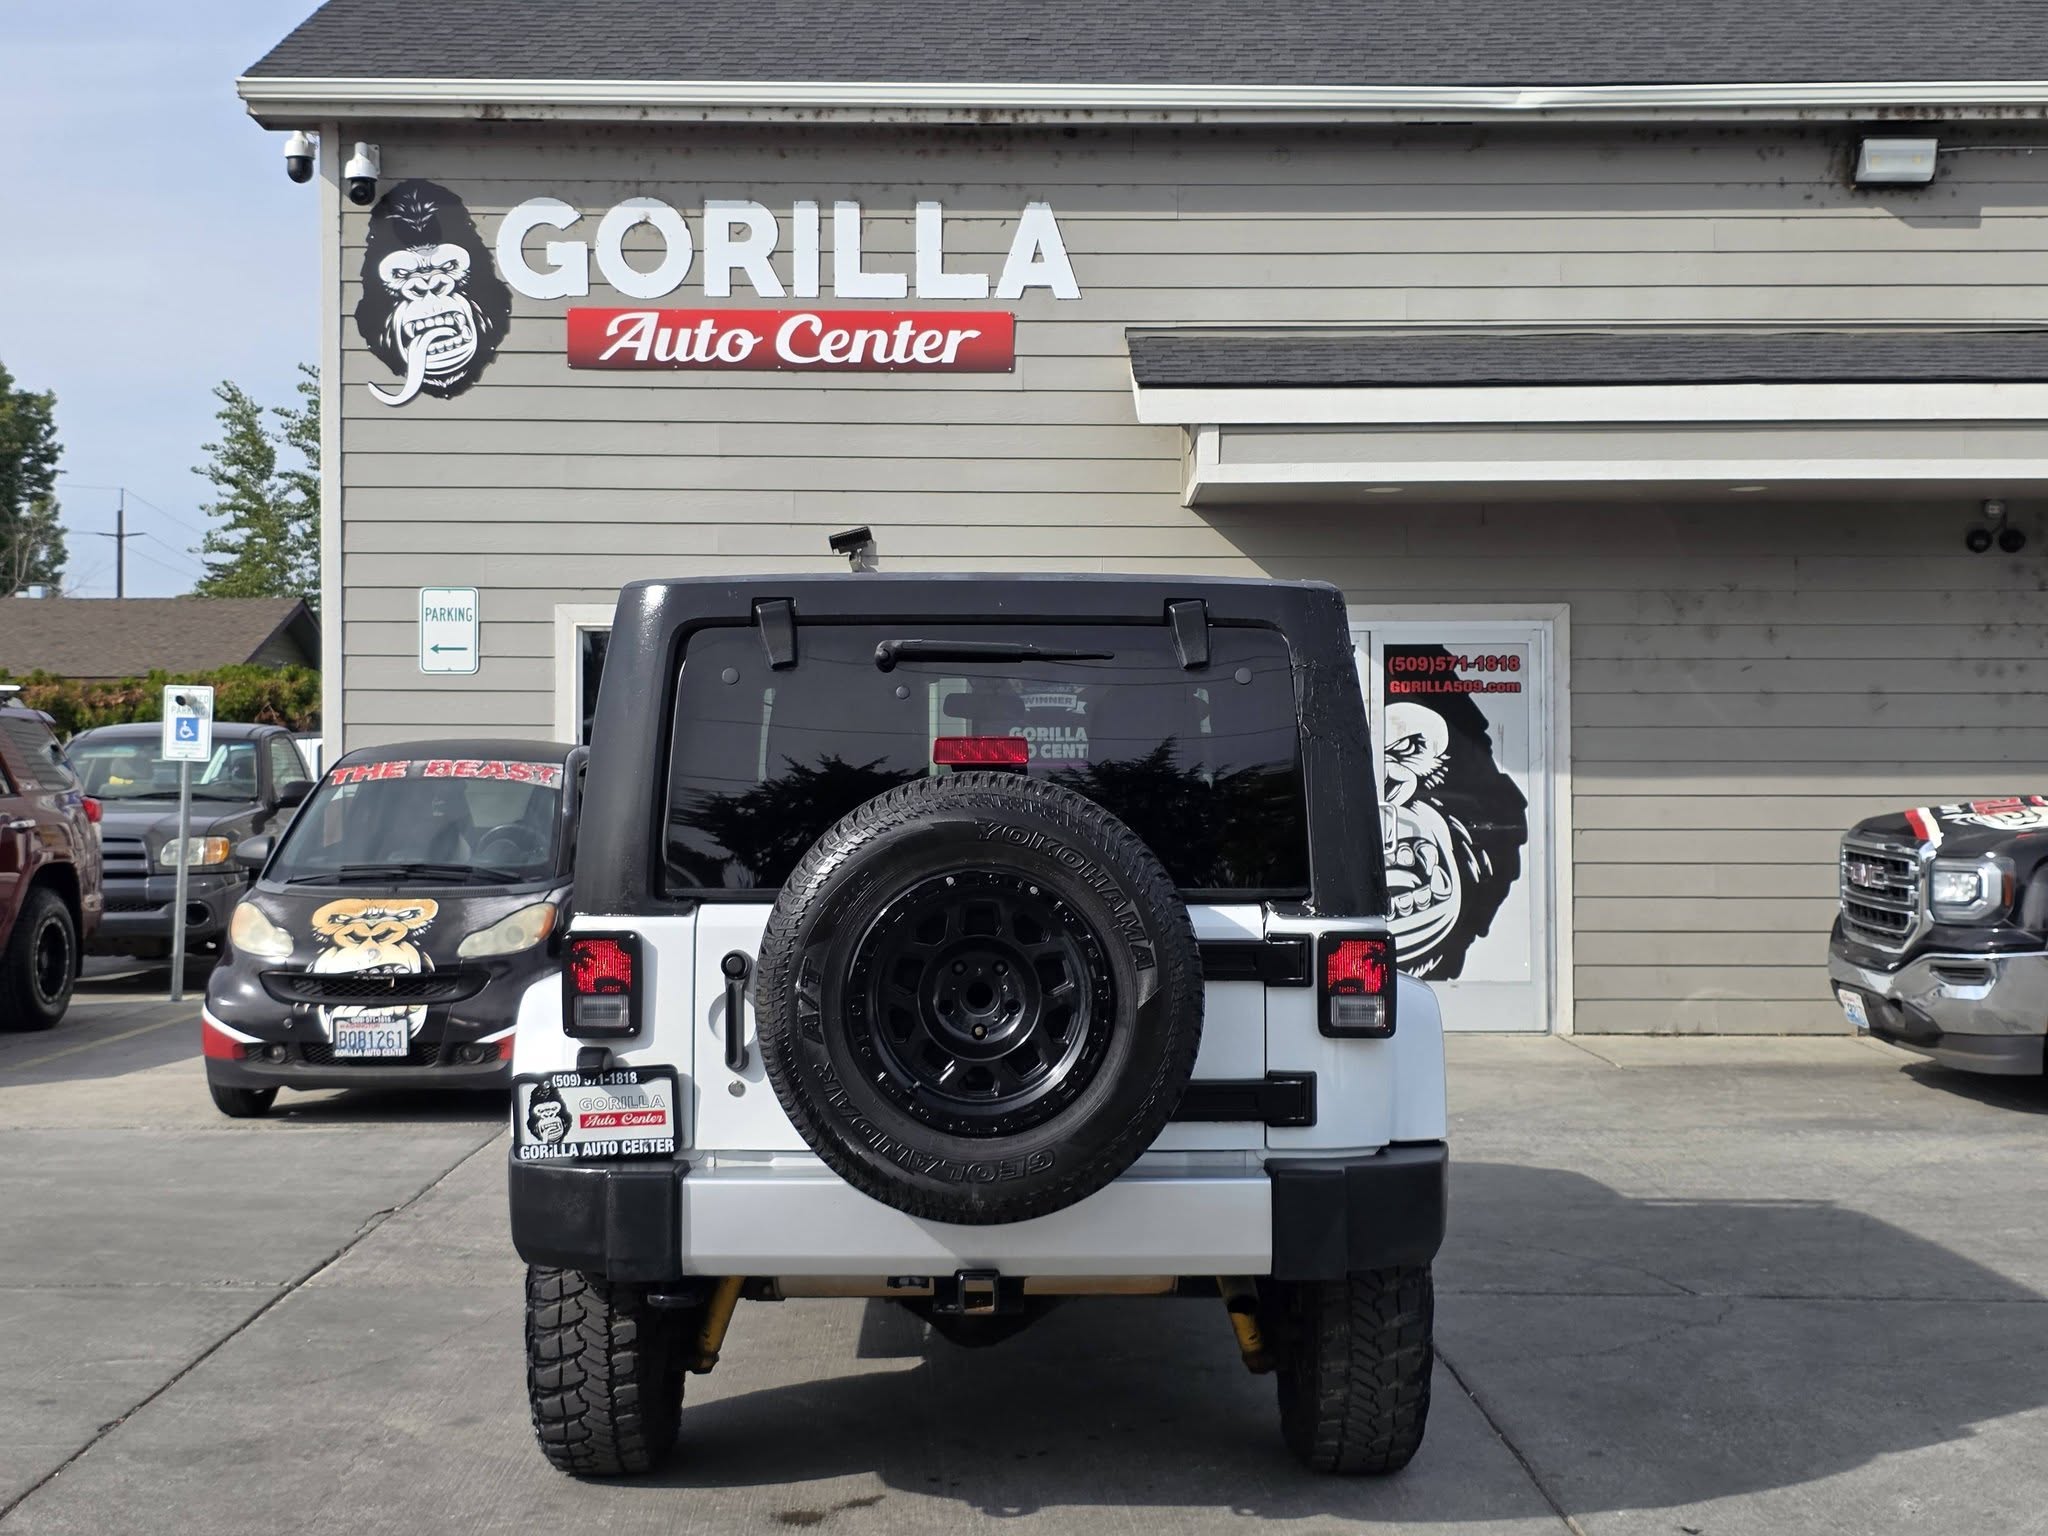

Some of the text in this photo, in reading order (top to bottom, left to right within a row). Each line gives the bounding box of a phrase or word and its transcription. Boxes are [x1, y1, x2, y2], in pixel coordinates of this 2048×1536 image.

[496, 197, 1082, 299] GORILLA
[599, 312, 982, 365] Auto Center
[425, 606, 473, 622] PARKING
[1388, 655, 1521, 675] (509)571-1818
[1389, 680, 1522, 694] GORILLA509.com
[1024, 696, 1073, 706] WINNER
[171, 705, 207, 716] PARKING
[1009, 727, 1088, 742] GORILLA
[1040, 743, 1089, 759] CENT
[330, 759, 563, 786] THE BEAST
[978, 822, 1156, 972] YOKOHAMA
[338, 1030, 403, 1050] BQB1261
[364, 1049, 381, 1057] AUTO
[382, 1048, 408, 1057] CENTER
[552, 1073, 581, 1088] (509)
[579, 1094, 666, 1111] GORILLA
[585, 1112, 665, 1128] Auto Center
[812, 1061, 1057, 1184] GEOLANDAR
[520, 1139, 675, 1160] GORILLA AUTO CENTER
